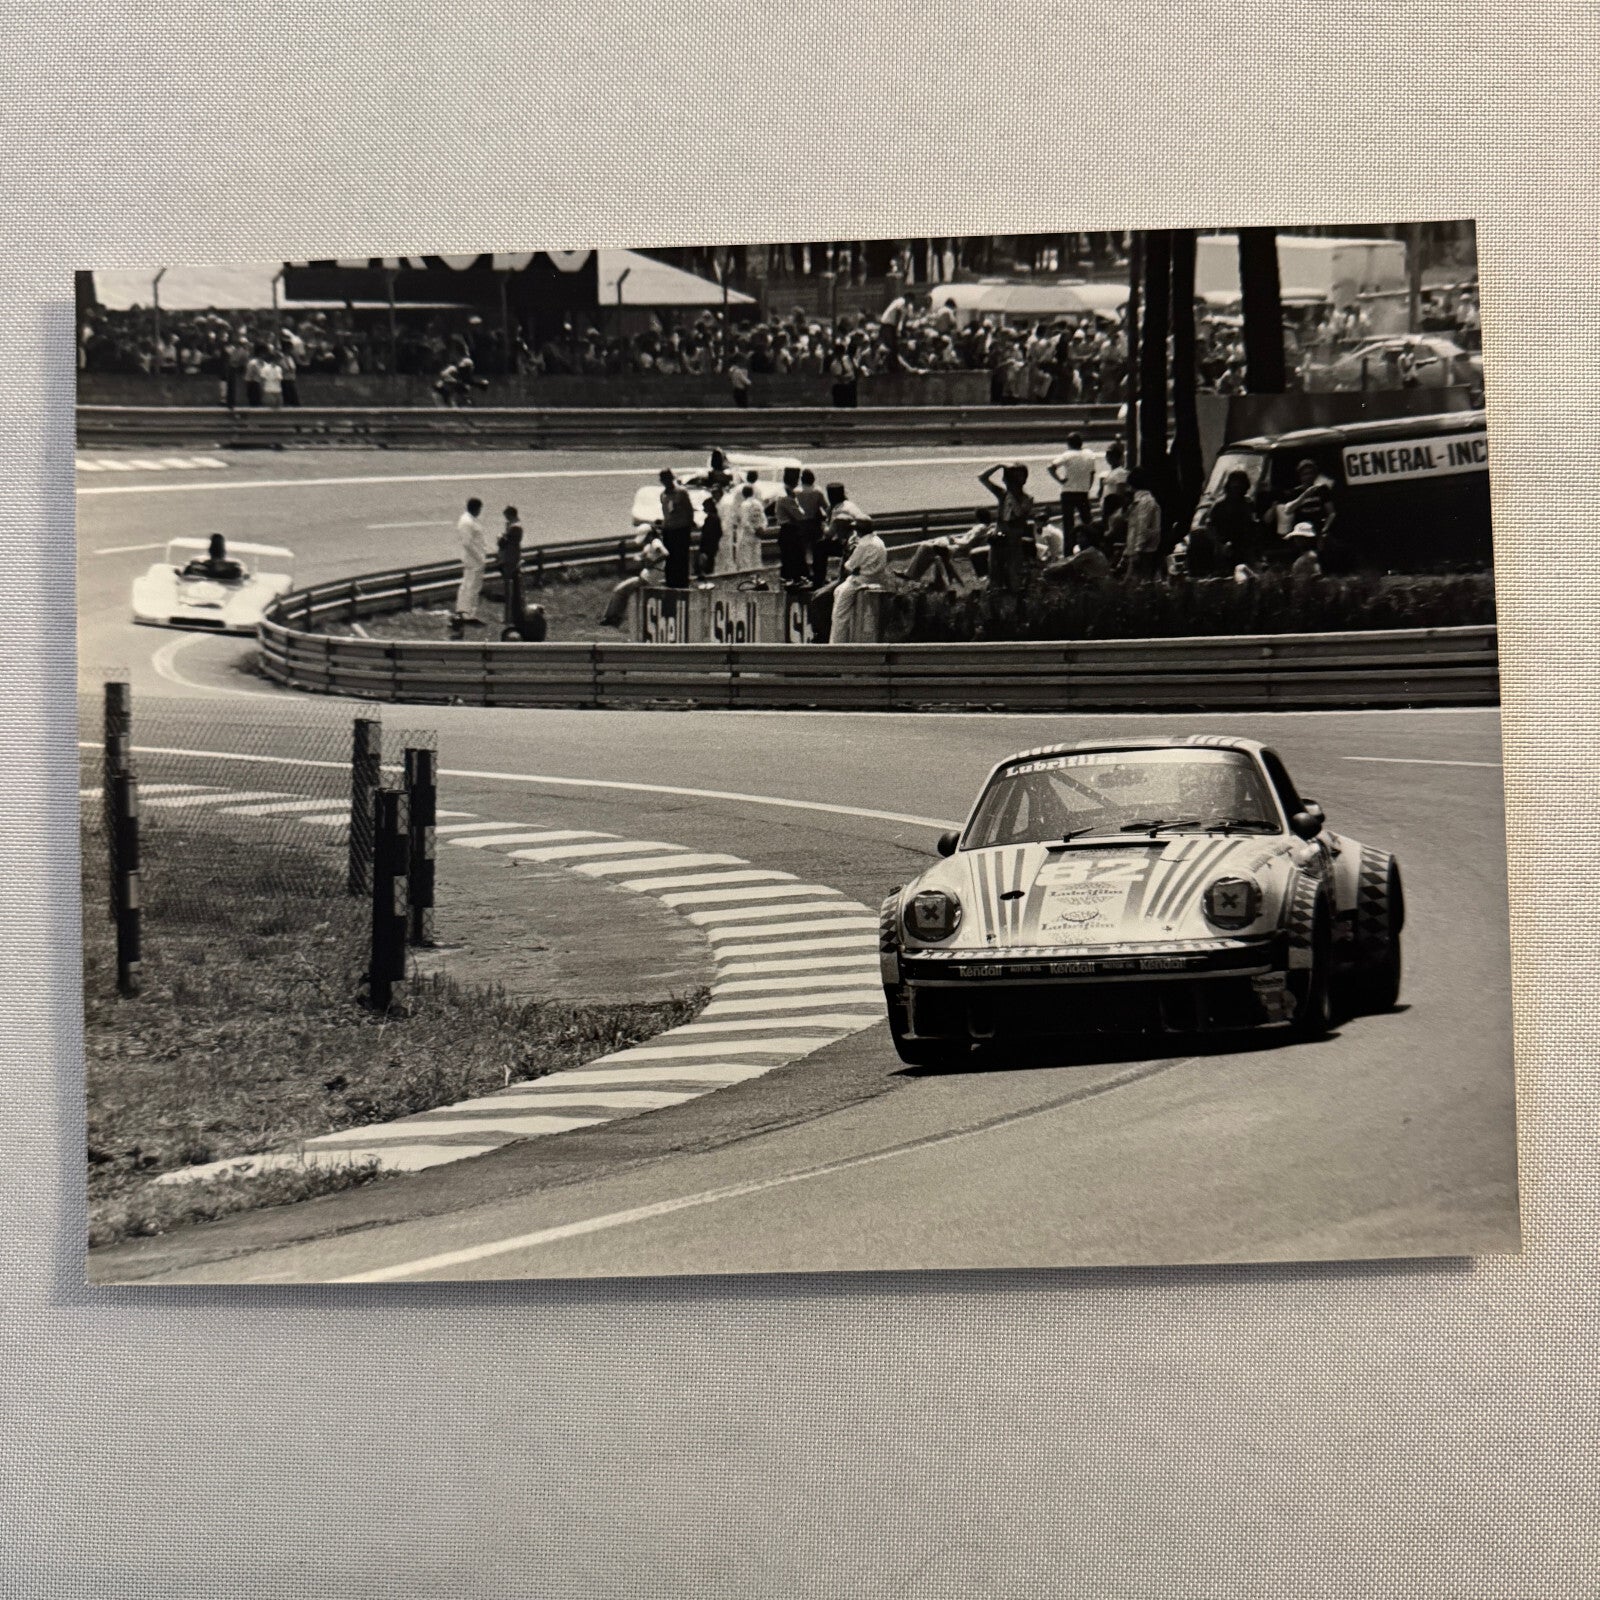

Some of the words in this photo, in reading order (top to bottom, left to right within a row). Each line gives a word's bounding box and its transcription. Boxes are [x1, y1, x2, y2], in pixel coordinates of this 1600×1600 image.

[646, 597, 686, 643] Shell
[713, 600, 757, 643] Shell
[1005, 755, 1118, 778] Lubrifilm
[1034, 857, 1150, 887] 82
[958, 965, 1003, 978] Kendall
[1049, 962, 1096, 975] Kendall
[1138, 957, 1188, 971] Kendall
